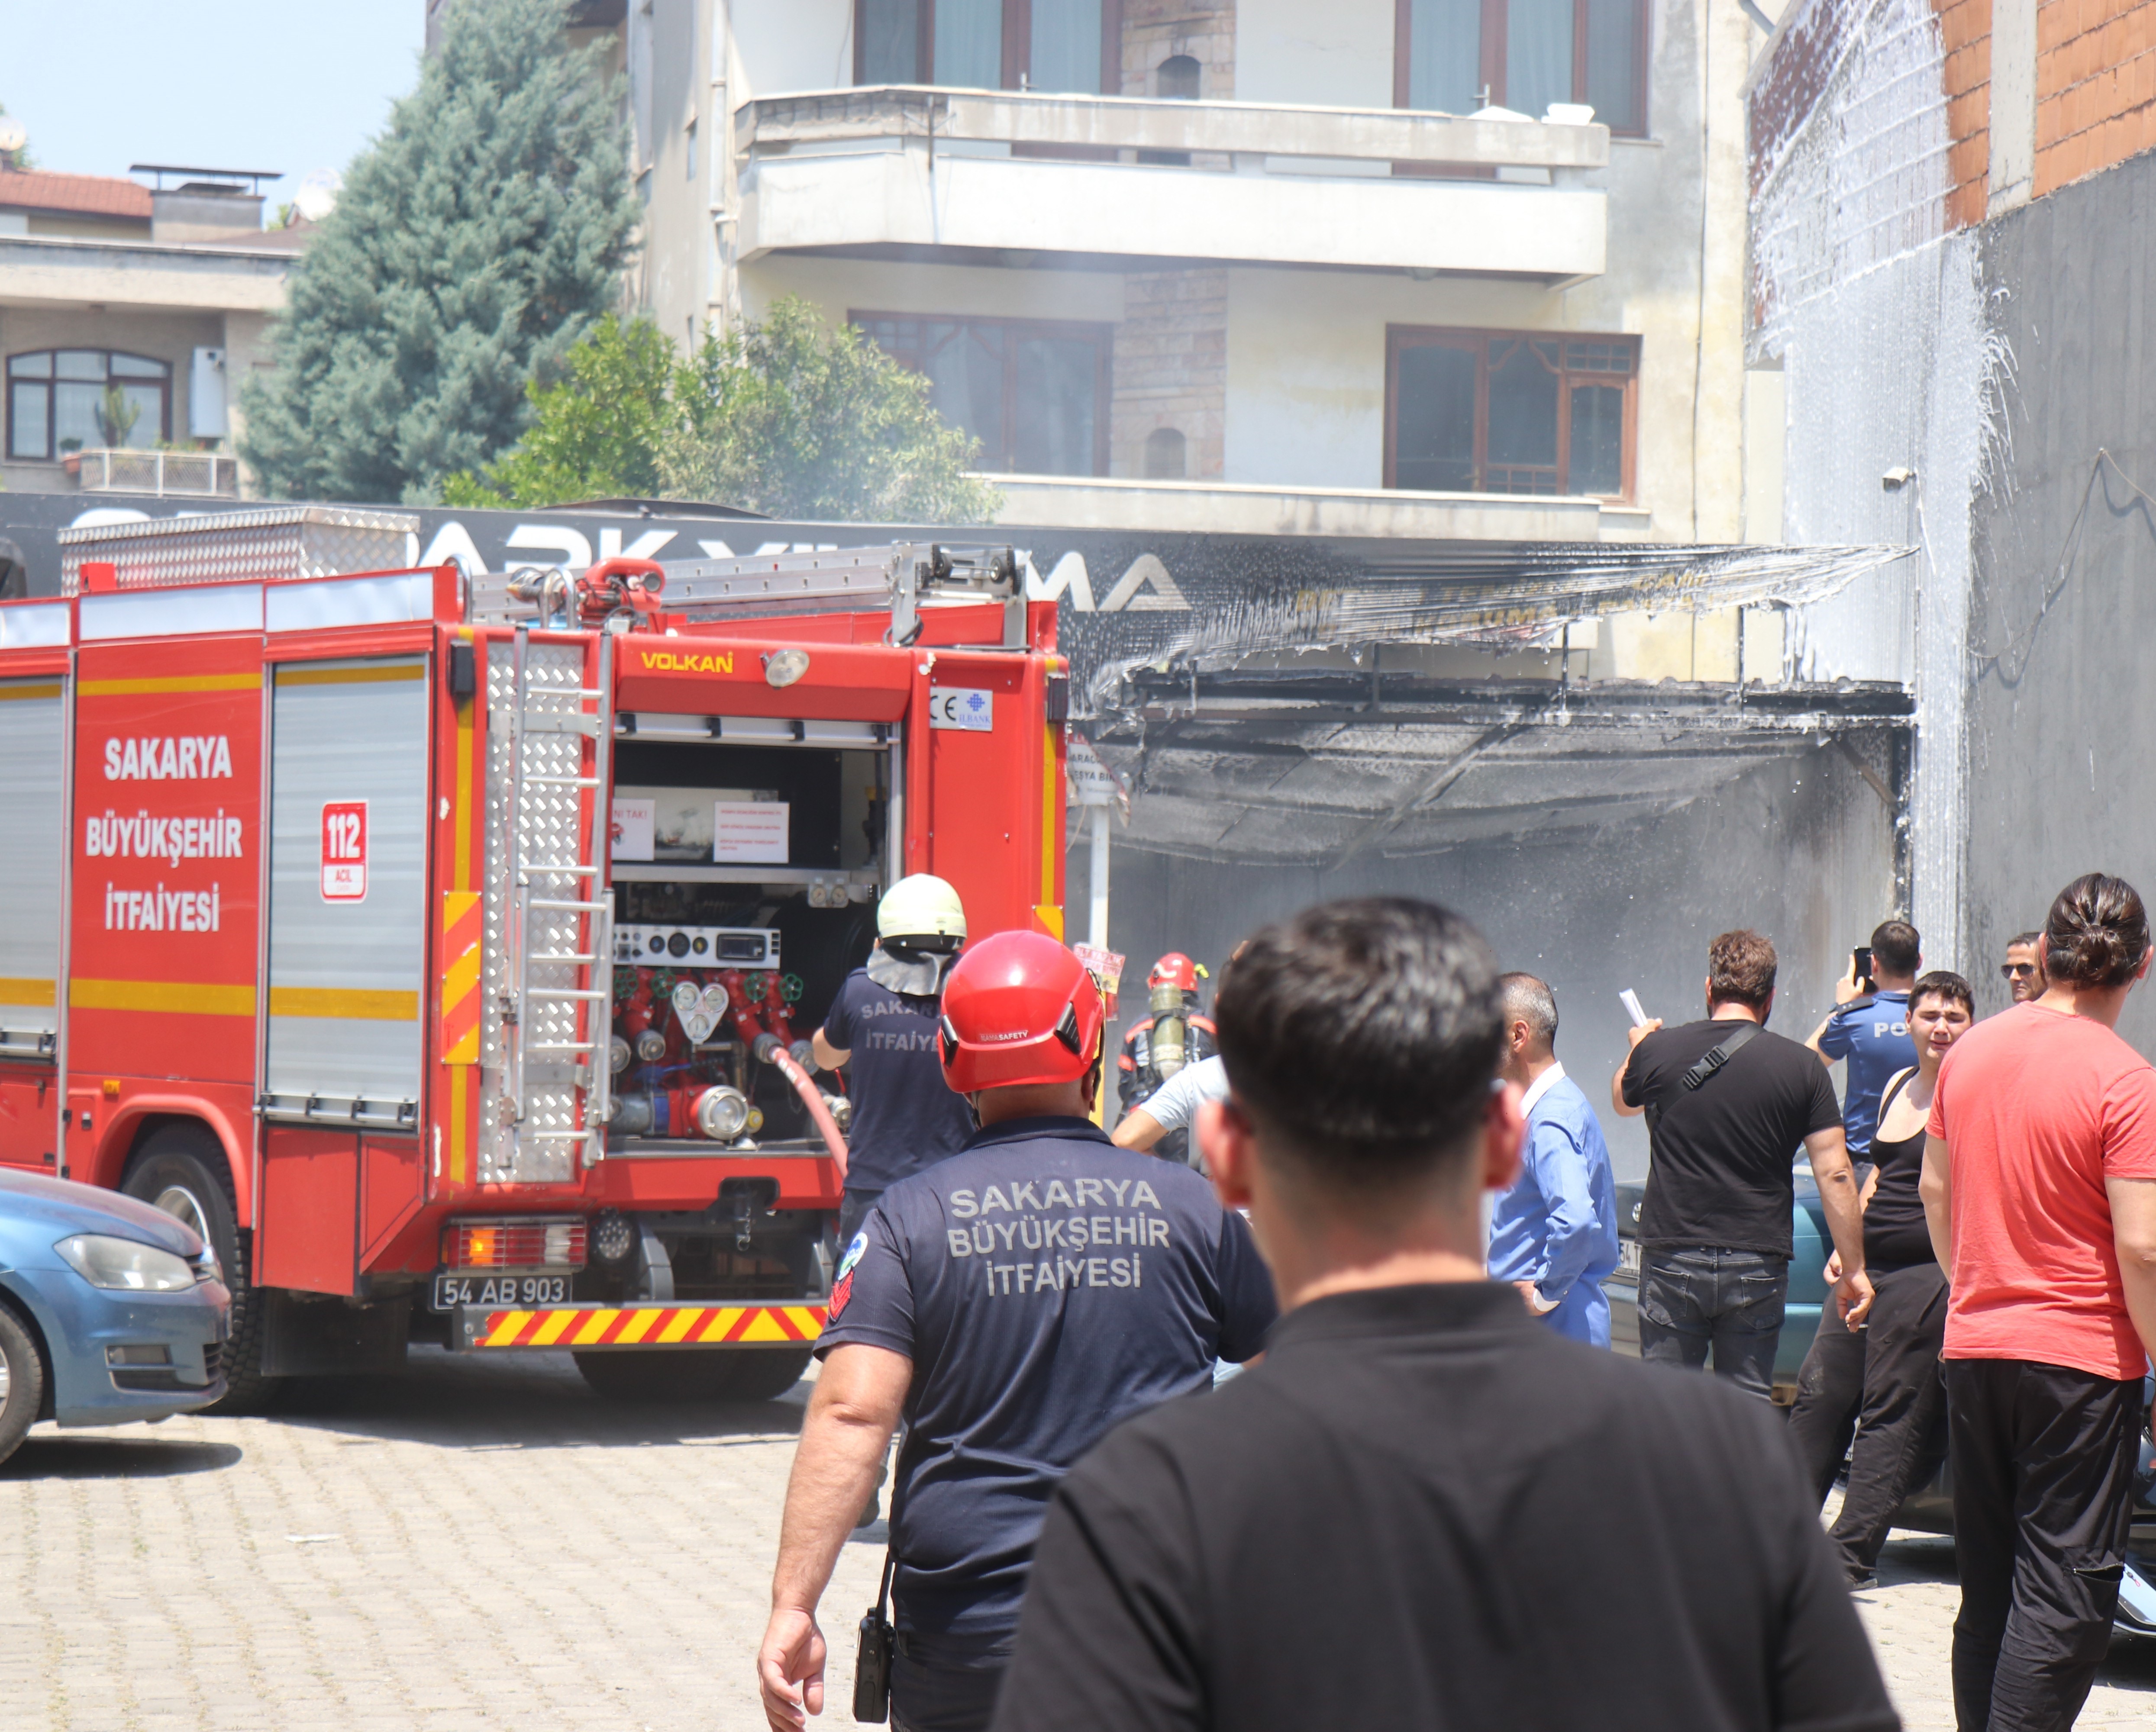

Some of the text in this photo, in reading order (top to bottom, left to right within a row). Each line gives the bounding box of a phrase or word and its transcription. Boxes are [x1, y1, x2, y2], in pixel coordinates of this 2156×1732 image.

[641, 652, 733, 674] VOLKAN
[104, 735, 233, 780] SAKARYA
[86, 808, 243, 869] BÜYÜKŞEHİR
[327, 812, 361, 859] 112
[105, 881, 220, 932] İTFAİYESİ
[861, 1000, 941, 1019] SAKAR
[950, 1178, 1162, 1218] SAKARYA
[947, 1212, 1170, 1257] BÜYÜKŞEHİR
[444, 1277, 564, 1305] 54 AB 903
[986, 1253, 1141, 1297] İTFAİYESİ
